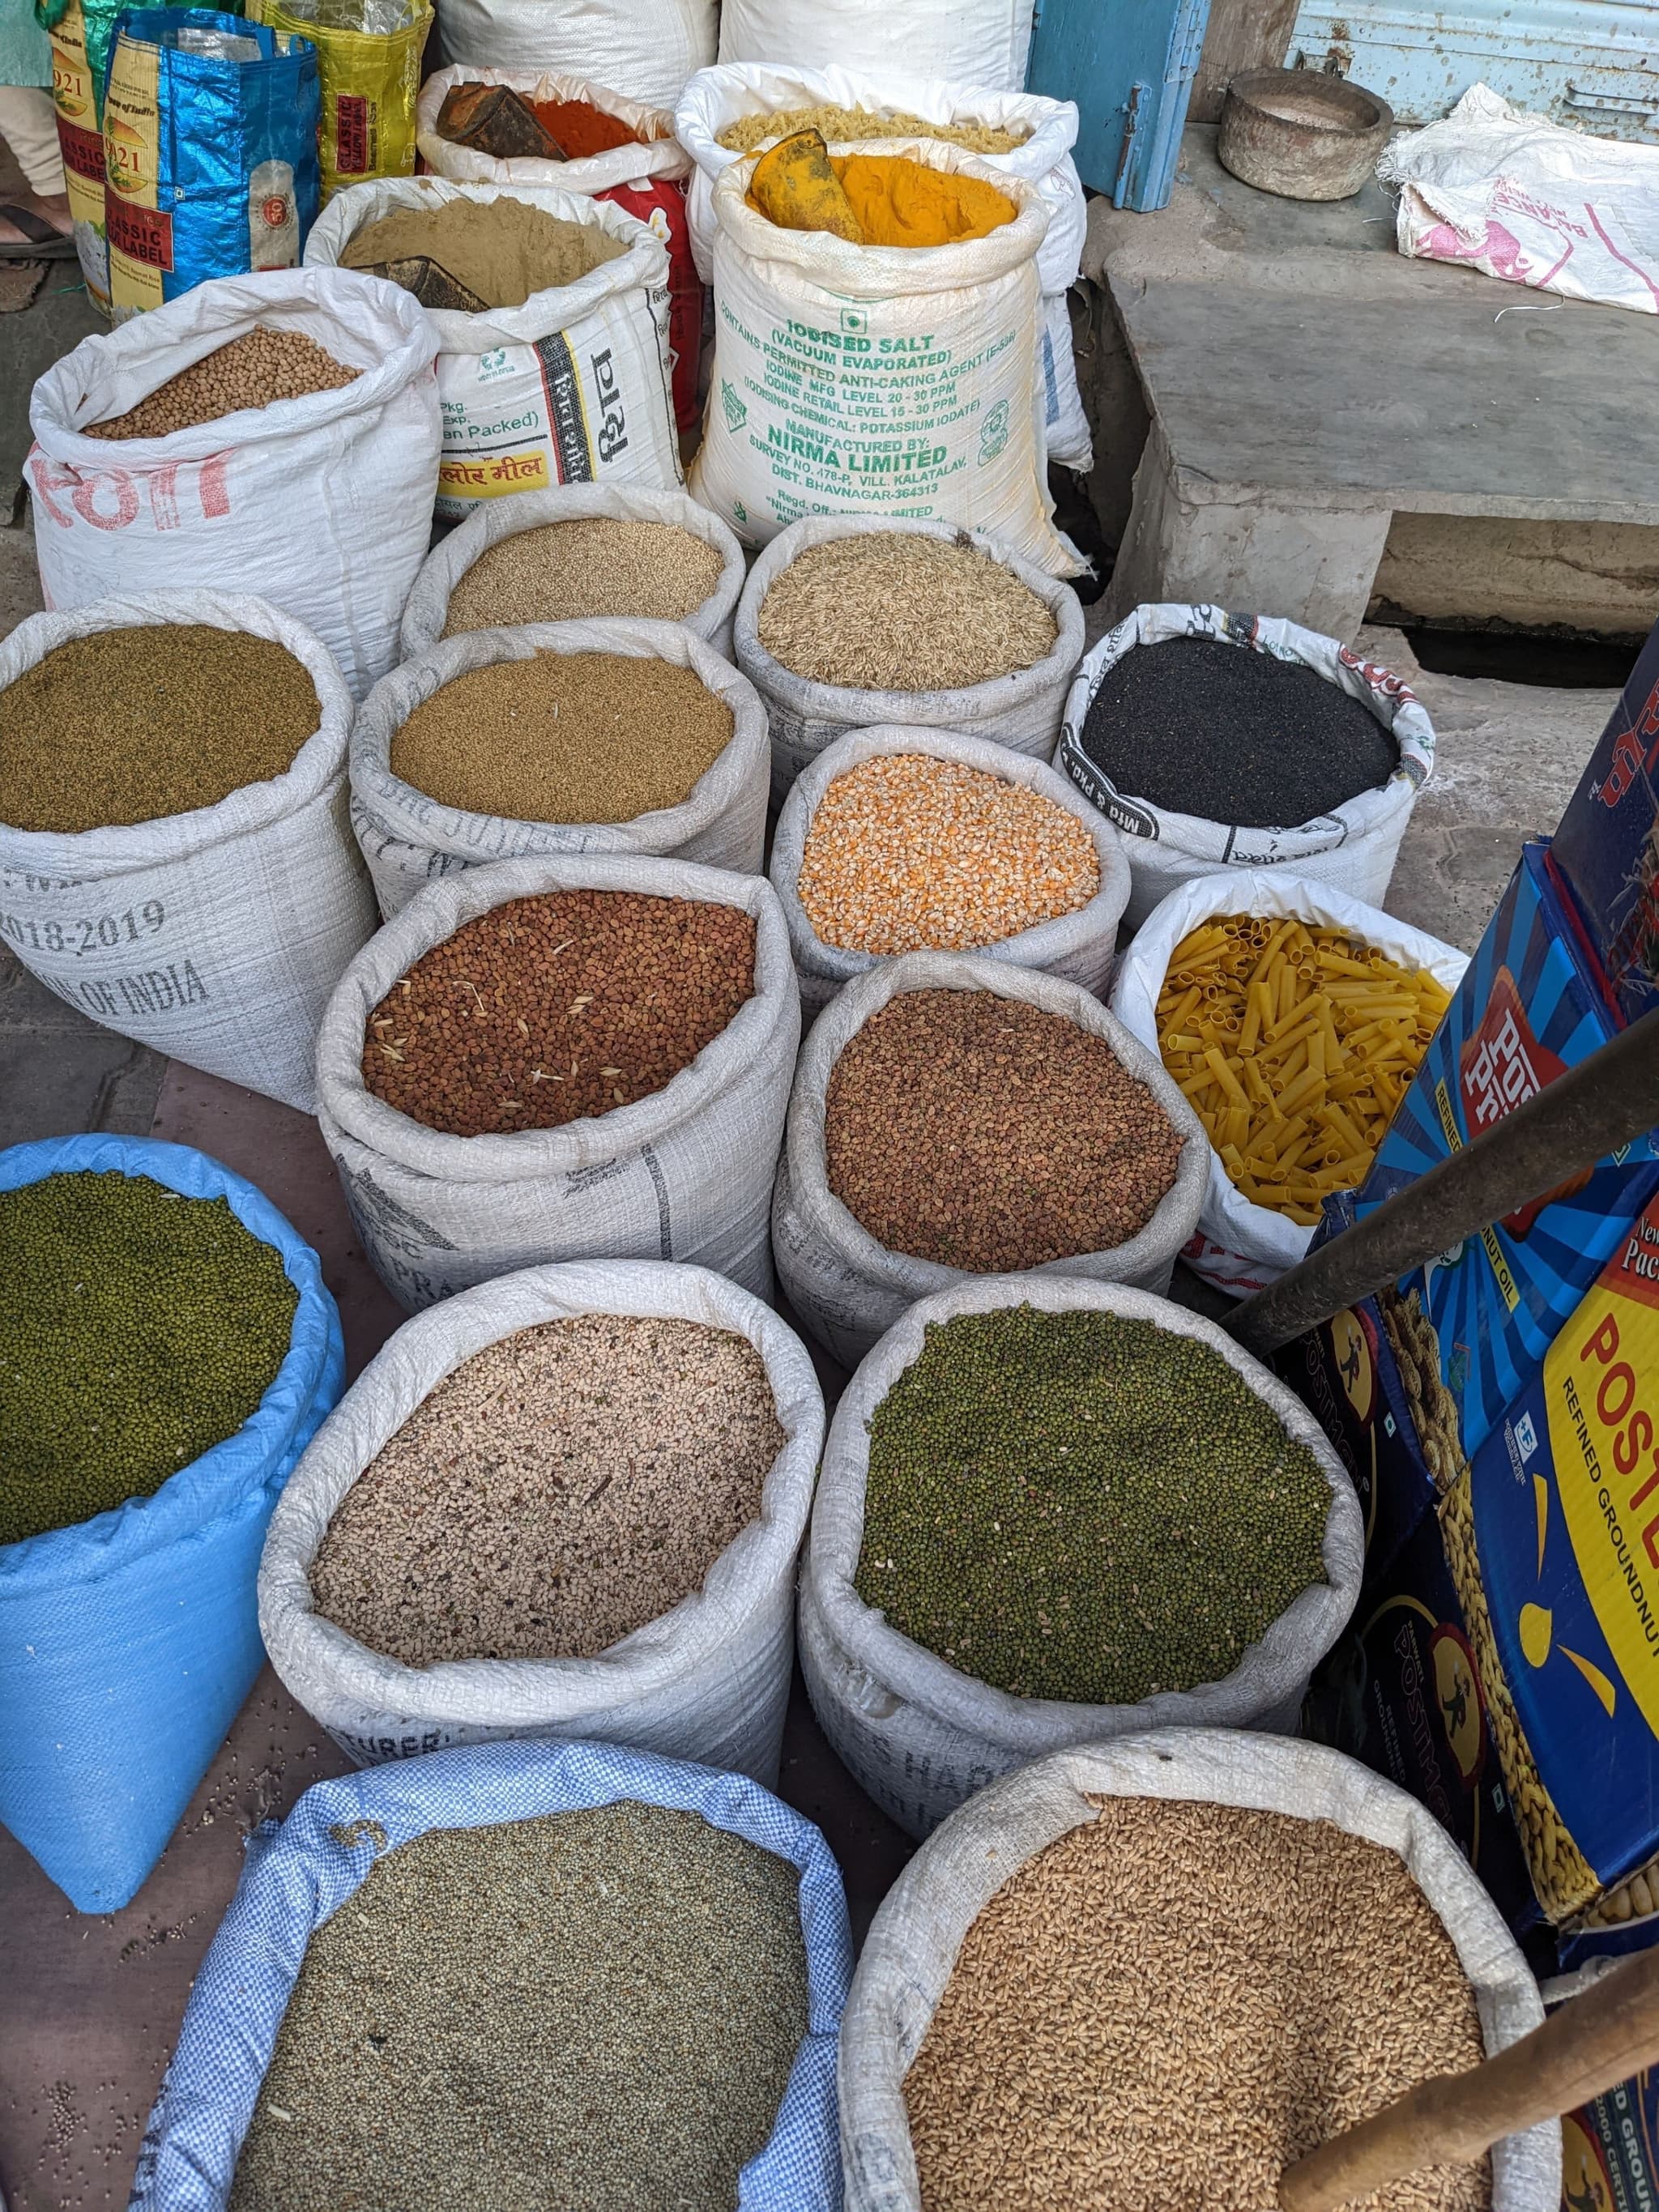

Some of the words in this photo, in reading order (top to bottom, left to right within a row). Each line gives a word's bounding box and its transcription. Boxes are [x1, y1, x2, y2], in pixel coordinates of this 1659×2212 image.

[720, 300, 760, 349] CONTAINS
[763, 343, 836, 382] PERMITTED
[839, 373, 936, 390] ANTI-CAKING
[939, 352, 983, 381] AGENT
[772, 328, 837, 364] (VACUUM
[842, 349, 952, 372] EVAPORATED)
[787, 319, 872, 352] IODISED
[879, 334, 935, 354] SALT
[764, 373, 800, 399] IODINE
[804, 392, 844, 414] RETAIL
[847, 405, 888, 417] LEVEL
[891, 406, 905, 417] 15
[916, 404, 930, 416] 30
[932, 394, 957, 411] PPM
[766, 360, 803, 386] IODINE
[809, 379, 835, 397] MFG
[842, 389, 882, 403] LEVEL
[888, 392, 902, 403] 20
[930, 381, 957, 399] PPM
[441, 403, 467, 414] Pkg.
[443, 415, 471, 427] Exp.
[468, 411, 539, 439] Packed)
[591, 347, 629, 463] शिव
[744, 375, 790, 410] (IODISING
[791, 402, 856, 433] CHEMICAL:
[859, 419, 935, 434] POTASSIUM
[936, 399, 980, 427] IODATE)
[768, 424, 842, 468] NIRMA
[848, 445, 947, 474] LIMITED
[786, 418, 902, 453] MANUFACTURED
[906, 437, 930, 451] BY:
[749, 434, 791, 465] SURVEY
[793, 458, 814, 475] NO.
[859, 475, 890, 487] VILL.
[772, 463, 803, 485] DIST.
[805, 477, 938, 501] BHAVNAGAR-364313
[777, 488, 808, 509] Regd.
[79, 978, 120, 1016] OF
[115, 958, 210, 1016] INDIA
[1621, 1238, 1659, 1281] Pac
[1499, 1268, 1513, 1304] OIL
[1563, 1376, 1601, 1483] REFINED
